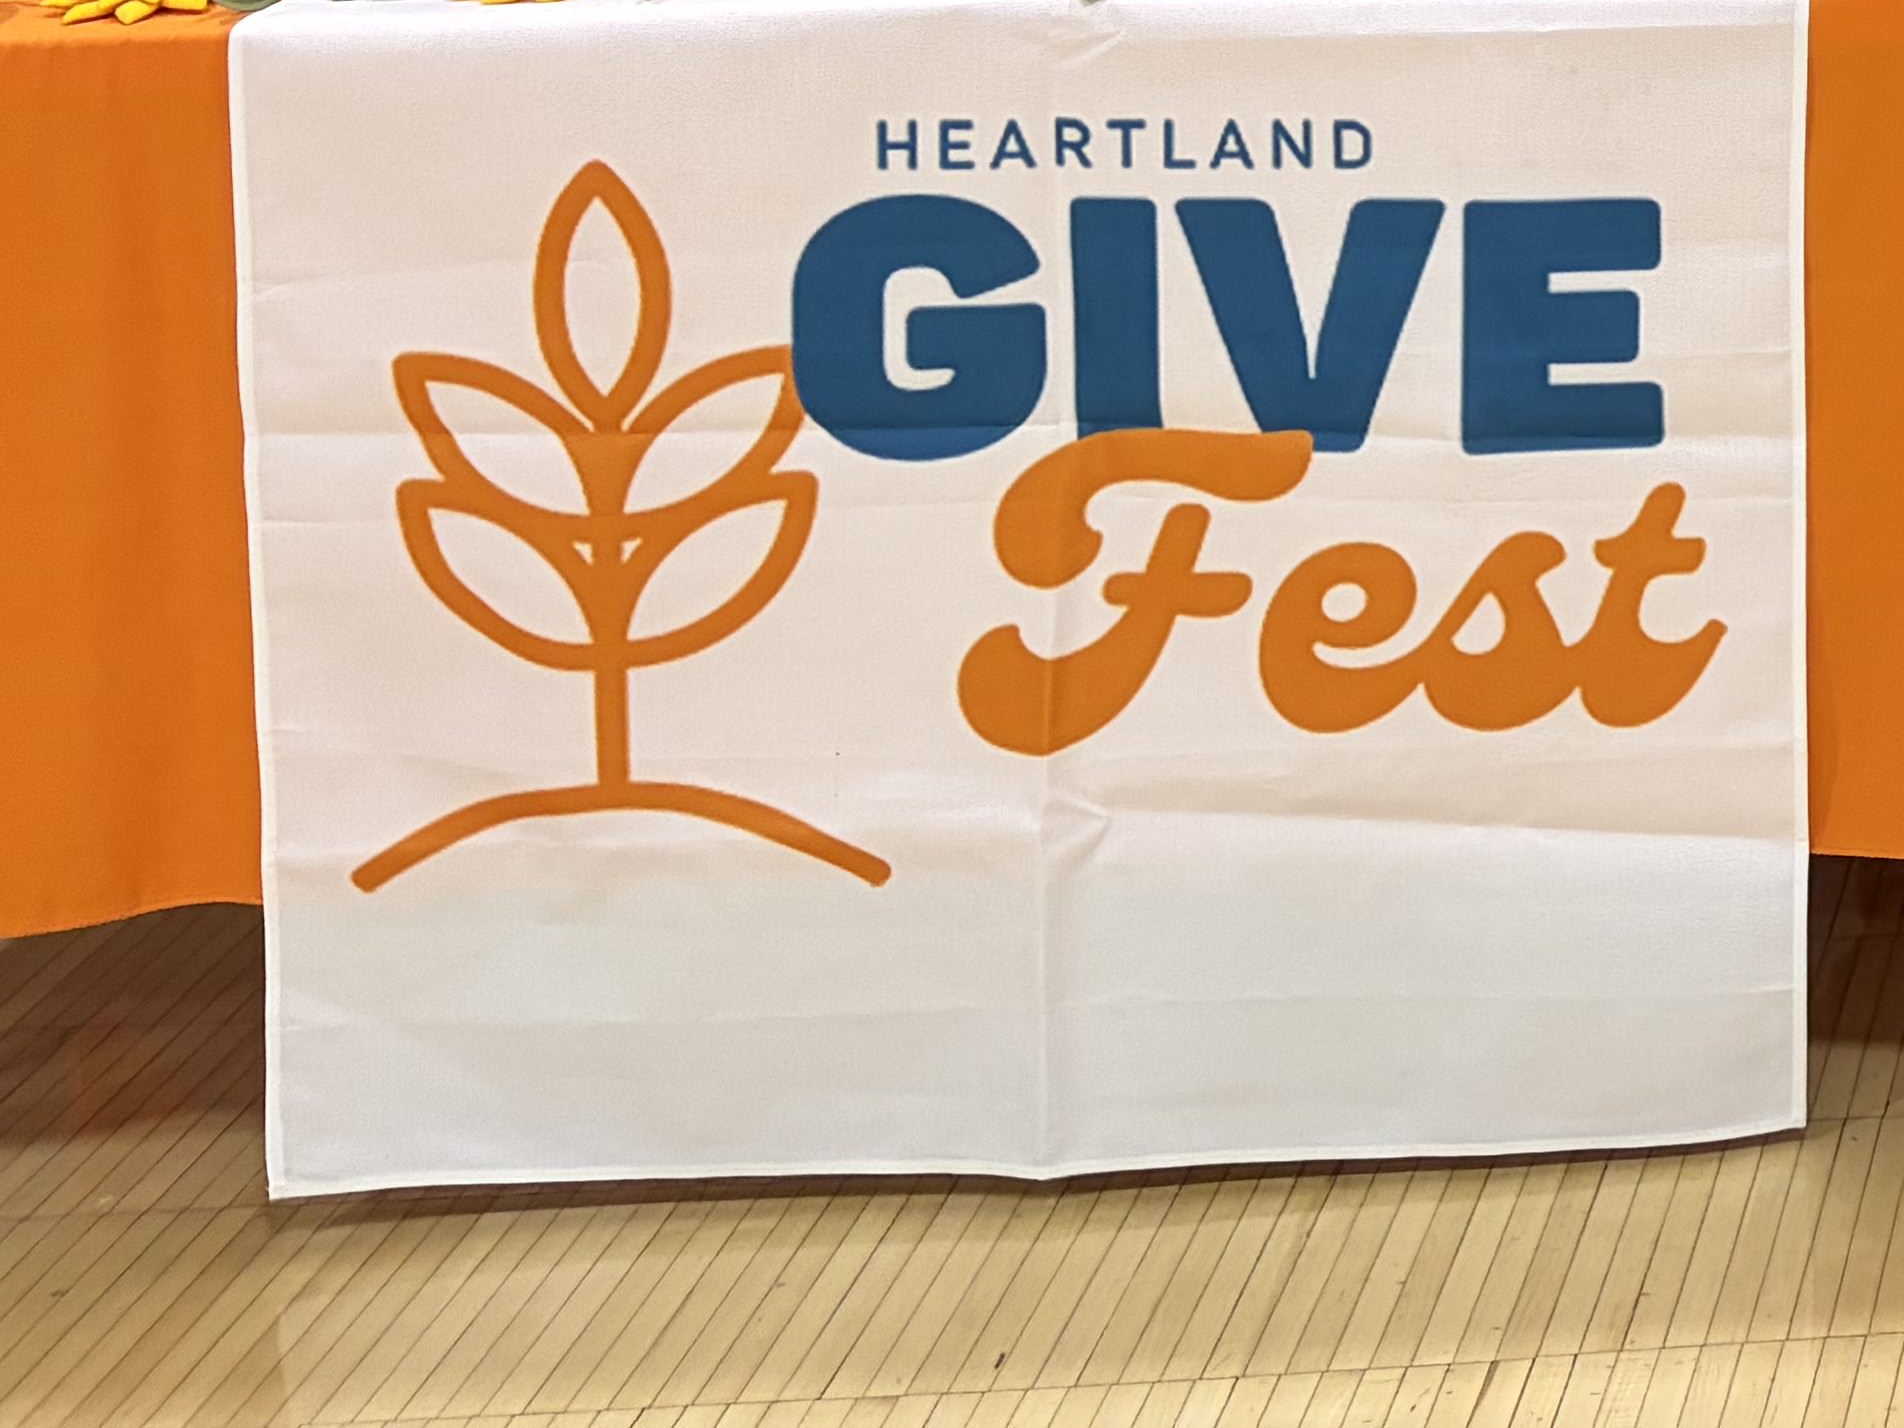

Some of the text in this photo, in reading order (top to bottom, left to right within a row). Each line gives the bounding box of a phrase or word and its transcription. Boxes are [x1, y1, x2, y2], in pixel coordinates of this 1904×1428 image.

[875, 117, 1373, 170] HEARTLAND
[791, 193, 1666, 461] GIVE
[956, 426, 1728, 757] Fest
